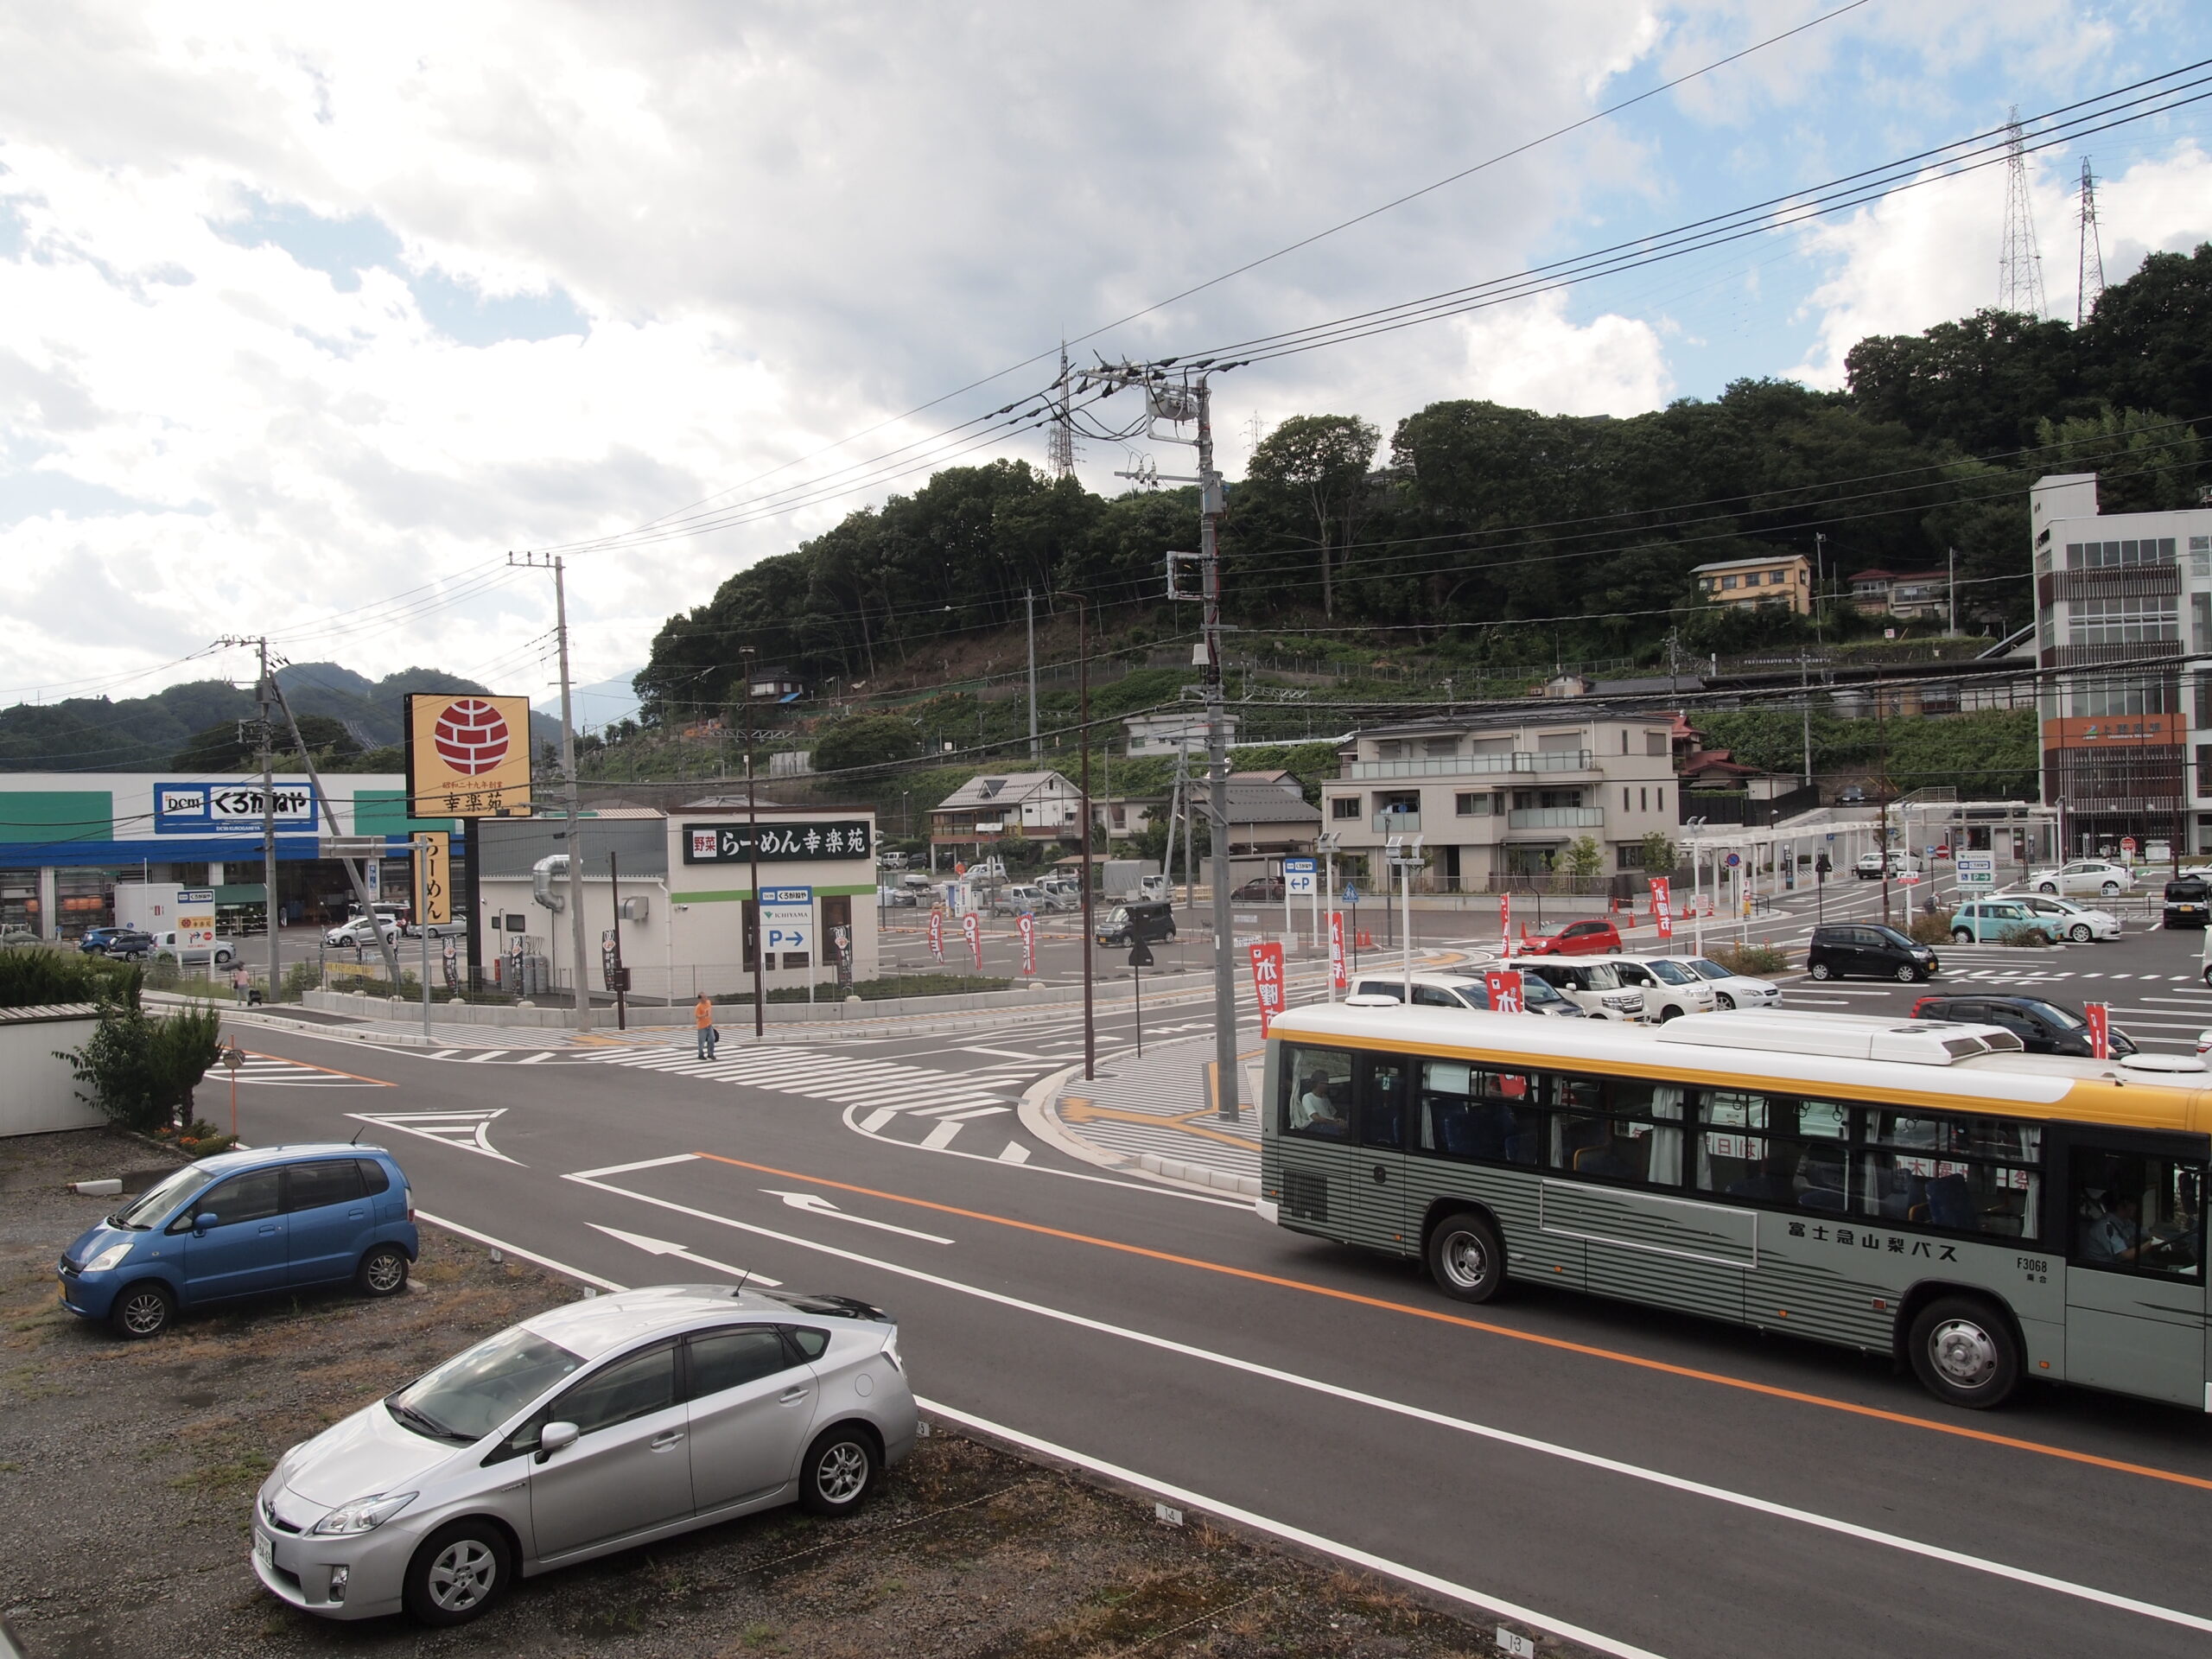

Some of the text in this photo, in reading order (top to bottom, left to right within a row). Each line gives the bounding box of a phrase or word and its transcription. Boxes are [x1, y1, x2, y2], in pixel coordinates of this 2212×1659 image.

[443, 791, 504, 812] 幸楽苑
[694, 836, 716, 852] 野菜
[1302, 877, 1310, 890] P
[769, 930, 783, 947] P
[1707, 1135, 1756, 1158] 日は
[1789, 1222, 1958, 1262] 富士急山梨バス
[2017, 1257, 2047, 1273] F3068
[1165, 1508, 1175, 1521] 14
[1510, 1635, 1522, 1652] 13
